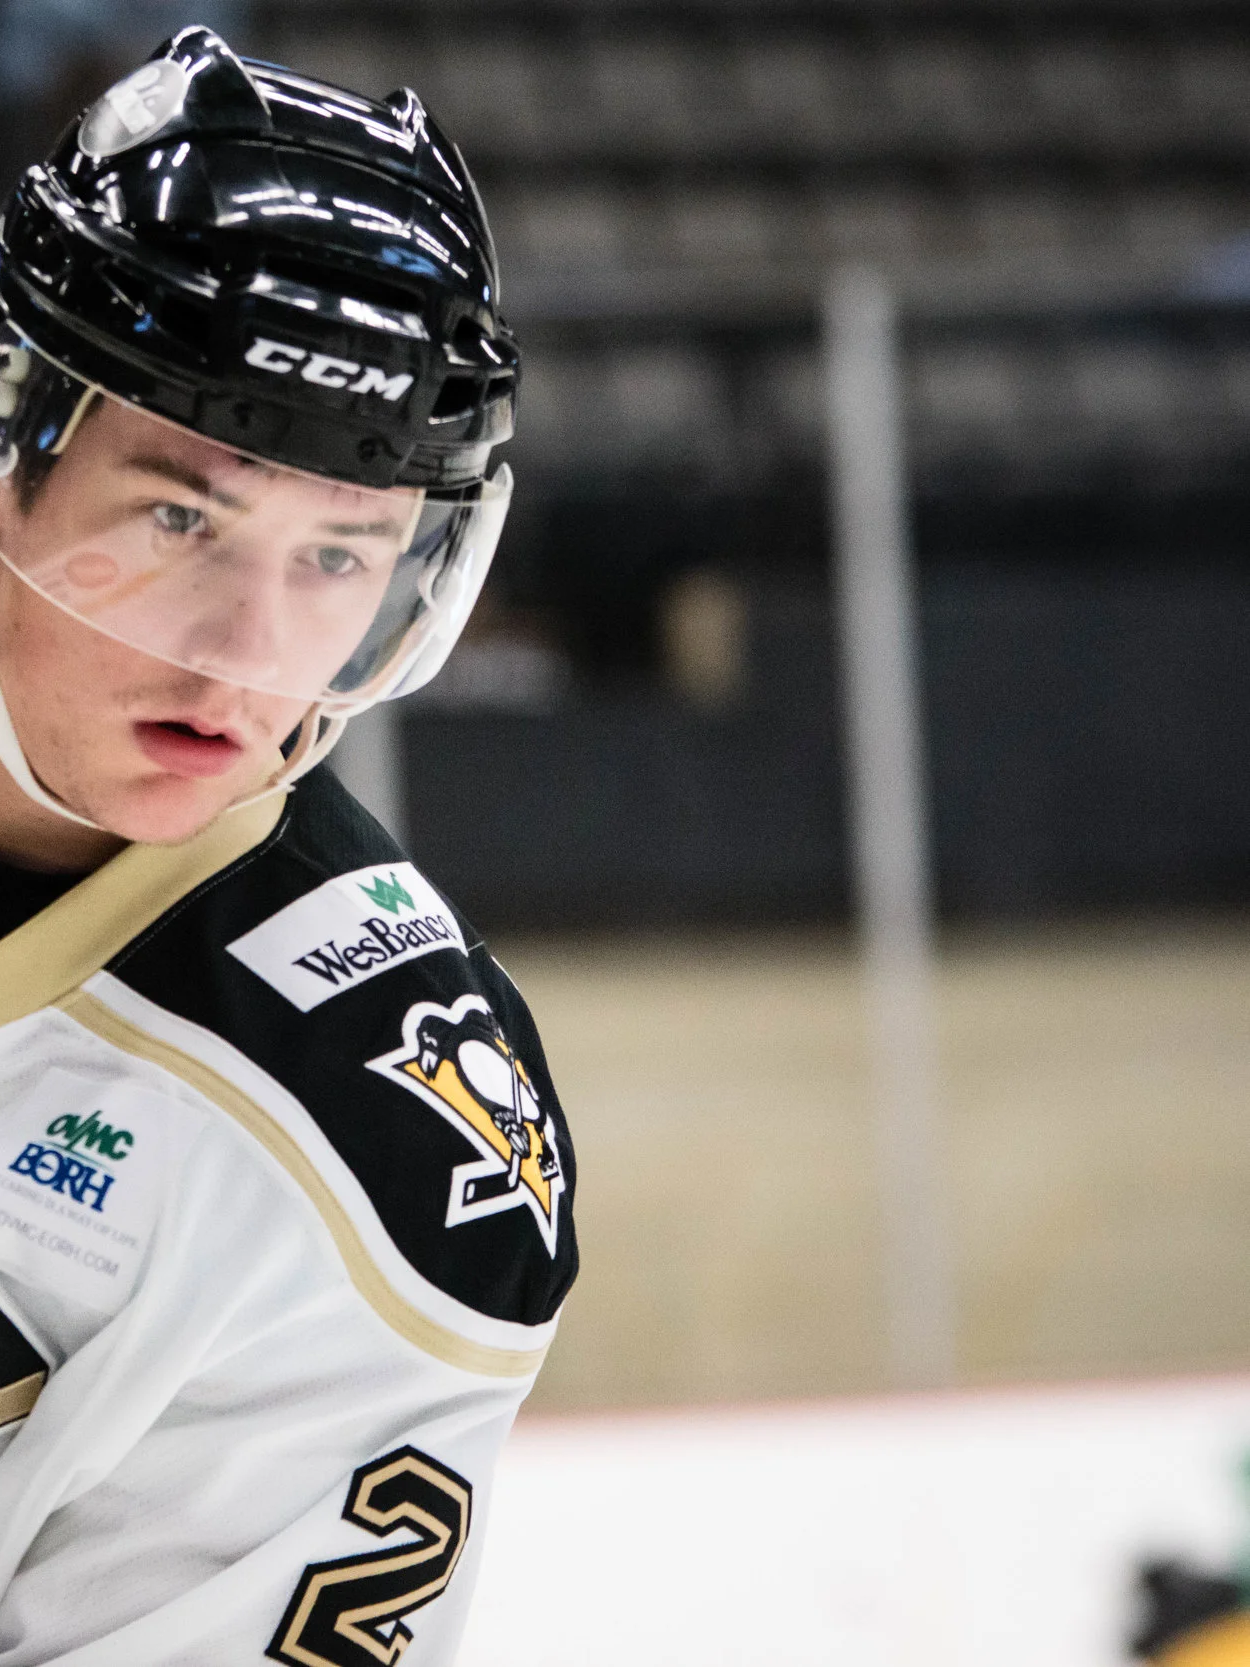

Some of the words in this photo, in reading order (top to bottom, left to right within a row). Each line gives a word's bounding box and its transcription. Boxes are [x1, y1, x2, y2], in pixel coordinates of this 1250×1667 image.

[243, 336, 415, 401] CCM
[292, 914, 458, 986] WesBanco
[264, 1444, 473, 1667] 2
